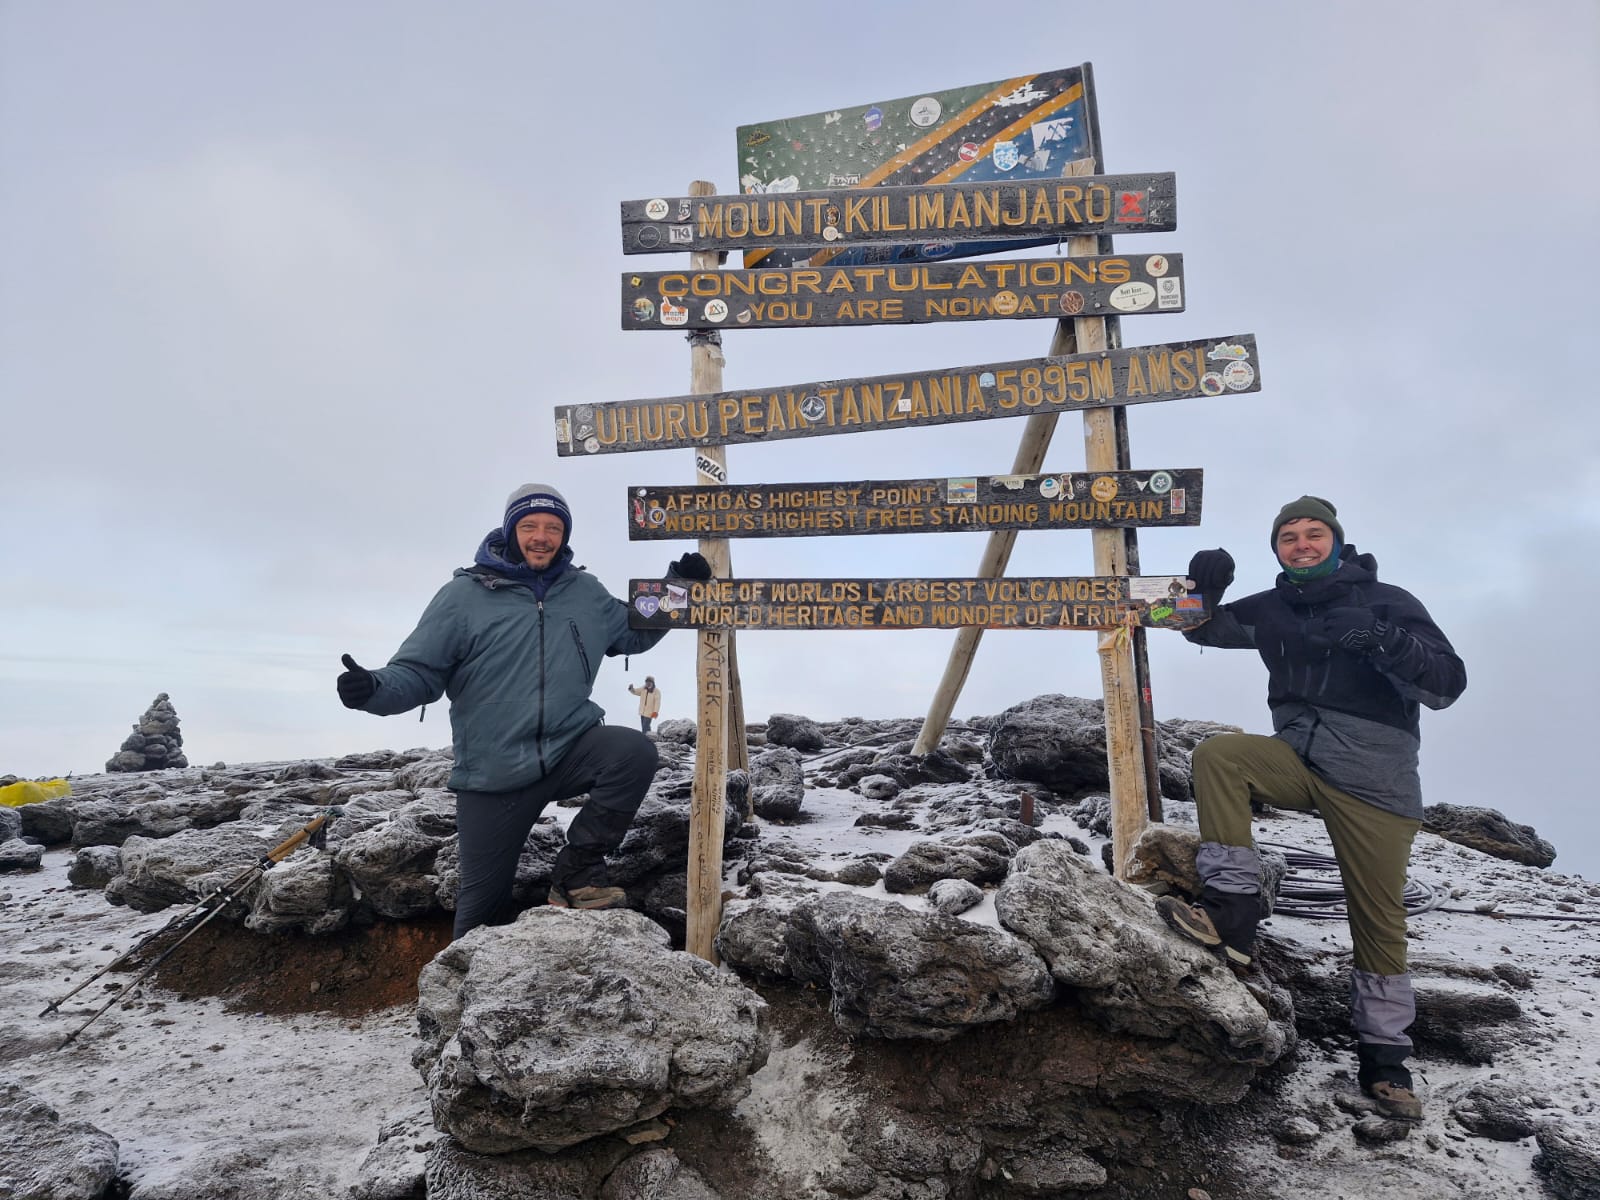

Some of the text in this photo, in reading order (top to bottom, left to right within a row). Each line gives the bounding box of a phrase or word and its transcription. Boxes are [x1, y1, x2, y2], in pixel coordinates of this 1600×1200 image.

[698, 185, 1111, 239] MOUNT KILIMANJARO
[658, 258, 1131, 297] CONGRATULATIONS
[749, 302, 813, 321] YOU
[836, 299, 904, 319] ARE
[926, 297, 996, 316] NOW
[1018, 294, 1059, 314] AT
[596, 402, 709, 445] UHURU
[997, 359, 1113, 409] 5895M
[696, 456, 727, 482] GRILO
[769, 489, 861, 509] HIGHEST
[873, 484, 936, 507] POINT
[763, 509, 858, 530] HIGHEST
[865, 507, 923, 527] FREE
[926, 504, 1039, 525] STANDING
[1049, 499, 1164, 521] MOUNTAIN
[691, 582, 734, 603] ONE
[739, 582, 765, 602] OF
[867, 581, 976, 602] LARGEST
[984, 580, 1121, 602] VOLCANOES
[689, 605, 762, 625] WORLD
[768, 605, 874, 625] HERITAGE
[881, 605, 926, 625] AND
[934, 605, 1018, 625] WONDER
[1025, 605, 1052, 625] OF
